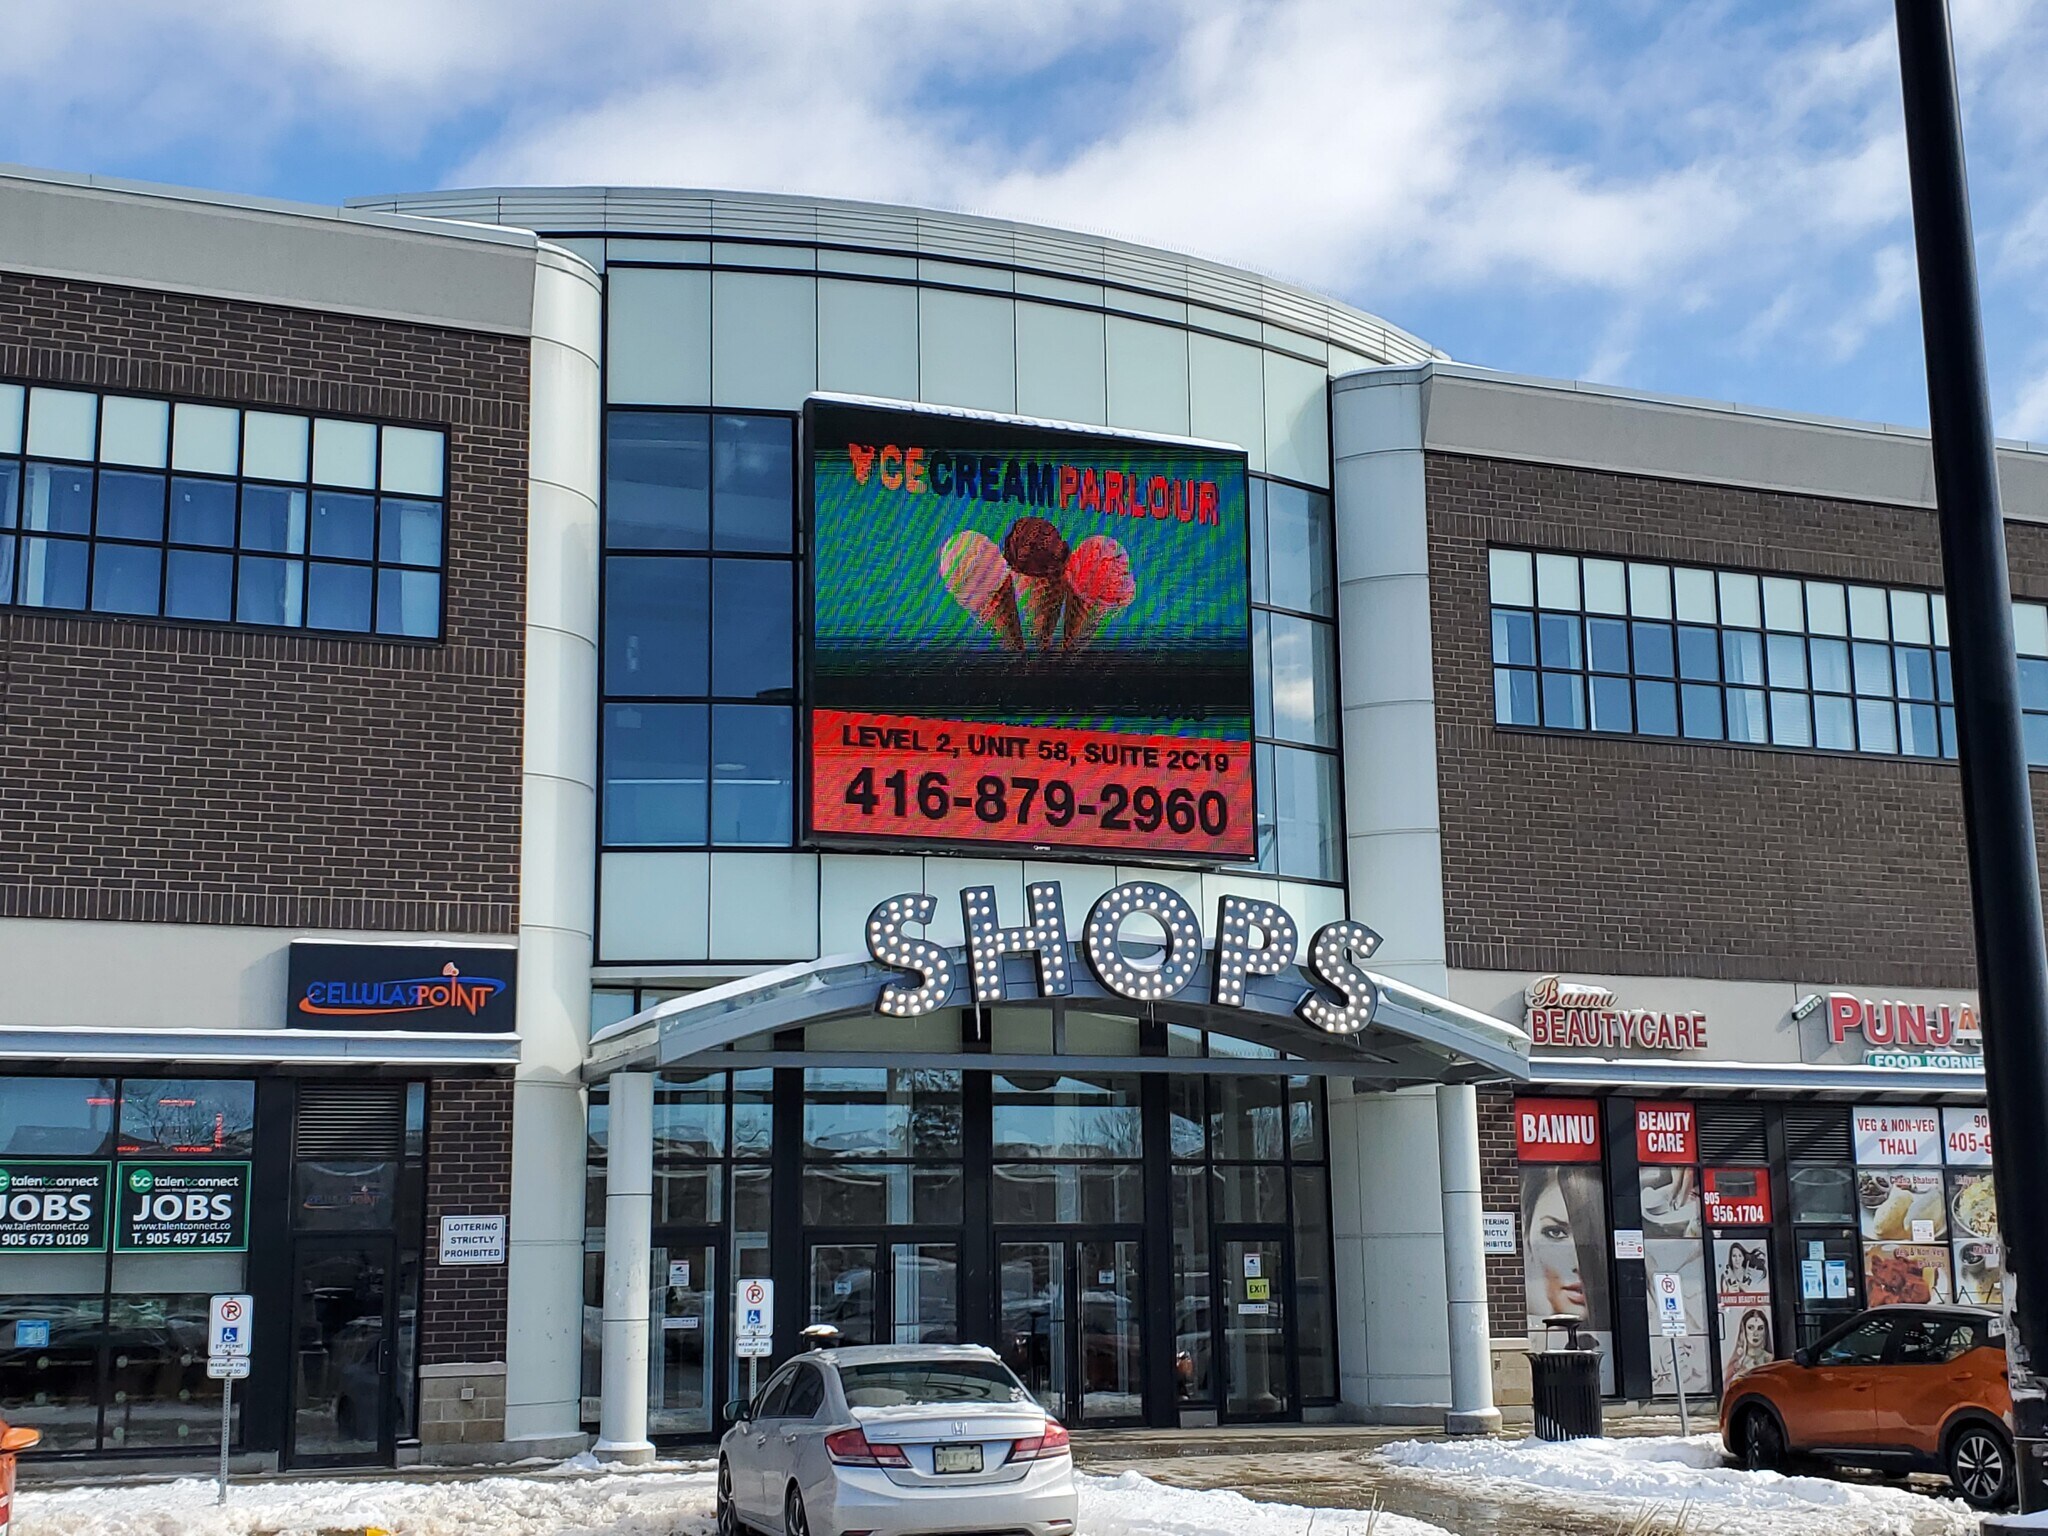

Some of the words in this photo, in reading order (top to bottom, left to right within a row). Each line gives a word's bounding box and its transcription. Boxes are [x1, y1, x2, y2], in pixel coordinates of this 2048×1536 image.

[1059, 464, 1221, 526] PARLOUR
[842, 724, 928, 751] LEVEL
[936, 733, 960, 759] 2,
[967, 735, 1030, 759] UNIT
[1038, 741, 1077, 765] 58,
[1084, 744, 1159, 768] SUITE
[1167, 750, 1230, 773] 2C19
[845, 766, 1229, 836] 416-879-2960
[866, 880, 1385, 1035] SHOPS
[1531, 976, 1619, 1008] Bannu
[1828, 993, 1984, 1047] PUNJA
[1874, 1055, 1922, 1068] FOOD
[1926, 1055, 1985, 1069] KORNE
[1638, 1111, 1691, 1132] BEAUTY
[1857, 1118, 1877, 1132] VEG
[1880, 1118, 1888, 1132] &
[1891, 1118, 1935, 1132] NON-VEG
[1974, 1115, 1988, 1128] 90
[1522, 1113, 1596, 1145] BANNU
[1647, 1132, 1685, 1153] CARE
[1879, 1138, 1918, 1155] THALI
[1949, 1132, 1992, 1154] 405-9
[11, 1175, 99, 1187] talentconnect
[154, 1175, 239, 1187] talentconnect
[1704, 1192, 1720, 1205] 905
[133, 1194, 232, 1221] JOBS
[1712, 1205, 1764, 1223] 956.1704
[132, 1222, 231, 1231] www.talentconnect.co
[448, 1223, 498, 1231] LOITERING
[1484, 1229, 1508, 1237] RICTLY
[1, 1233, 27, 1246] 905
[29, 1233, 54, 1246] 673
[56, 1233, 89, 1246] 0109
[146, 1232, 170, 1245] 905
[173, 1232, 197, 1245] 497
[200, 1232, 232, 1245] 1457
[450, 1235, 495, 1244] STRICTLY
[444, 1249, 500, 1257] PROHIBITED
[1249, 1284, 1267, 1294] EXIT
